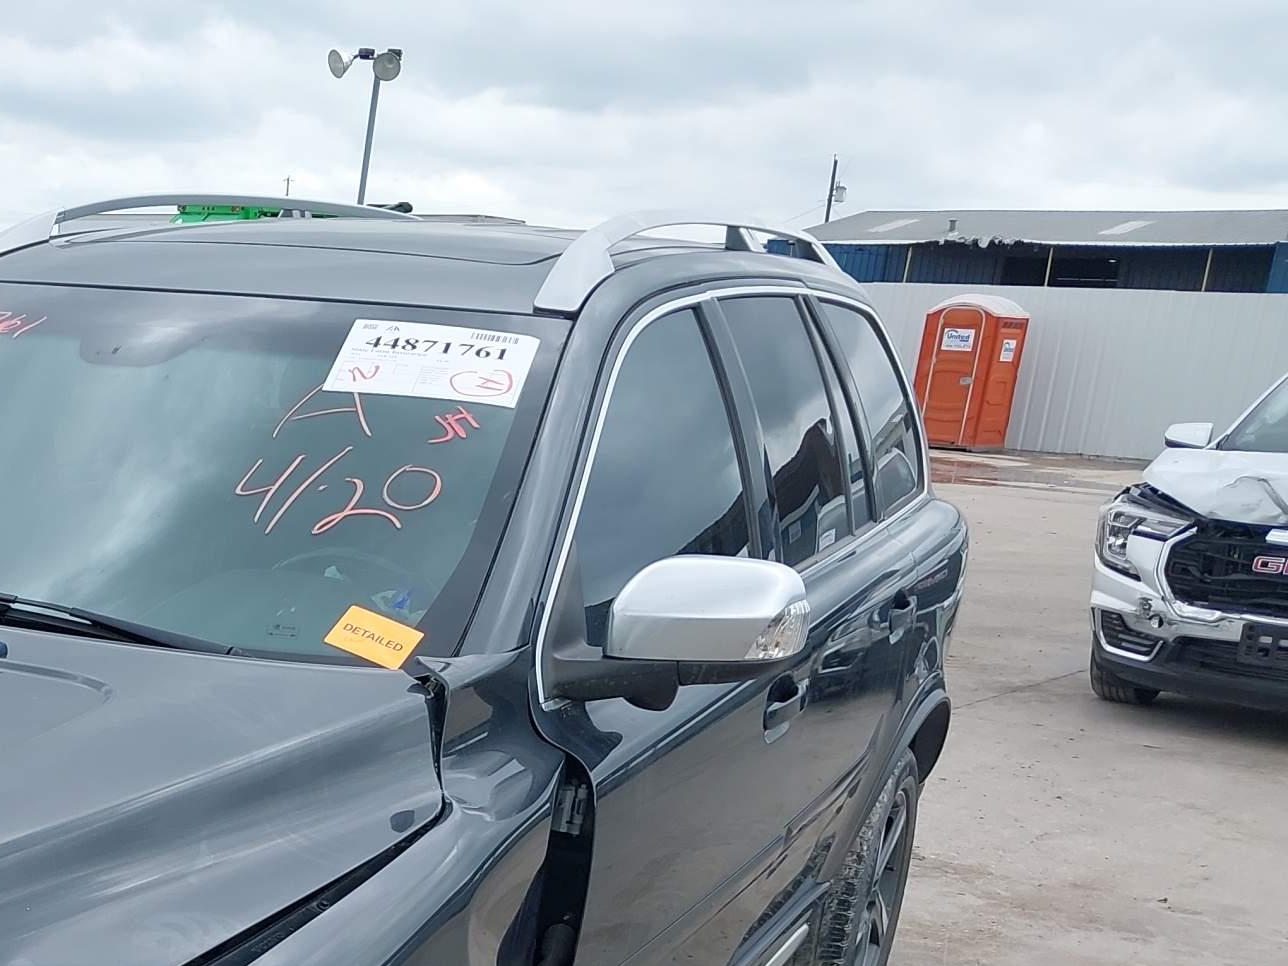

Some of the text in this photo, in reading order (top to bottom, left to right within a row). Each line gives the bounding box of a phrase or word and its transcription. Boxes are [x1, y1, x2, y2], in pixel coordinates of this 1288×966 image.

[365, 335, 509, 361] 44871761
[1252, 555, 1288, 576] G
[342, 622, 404, 652] DETAILED
